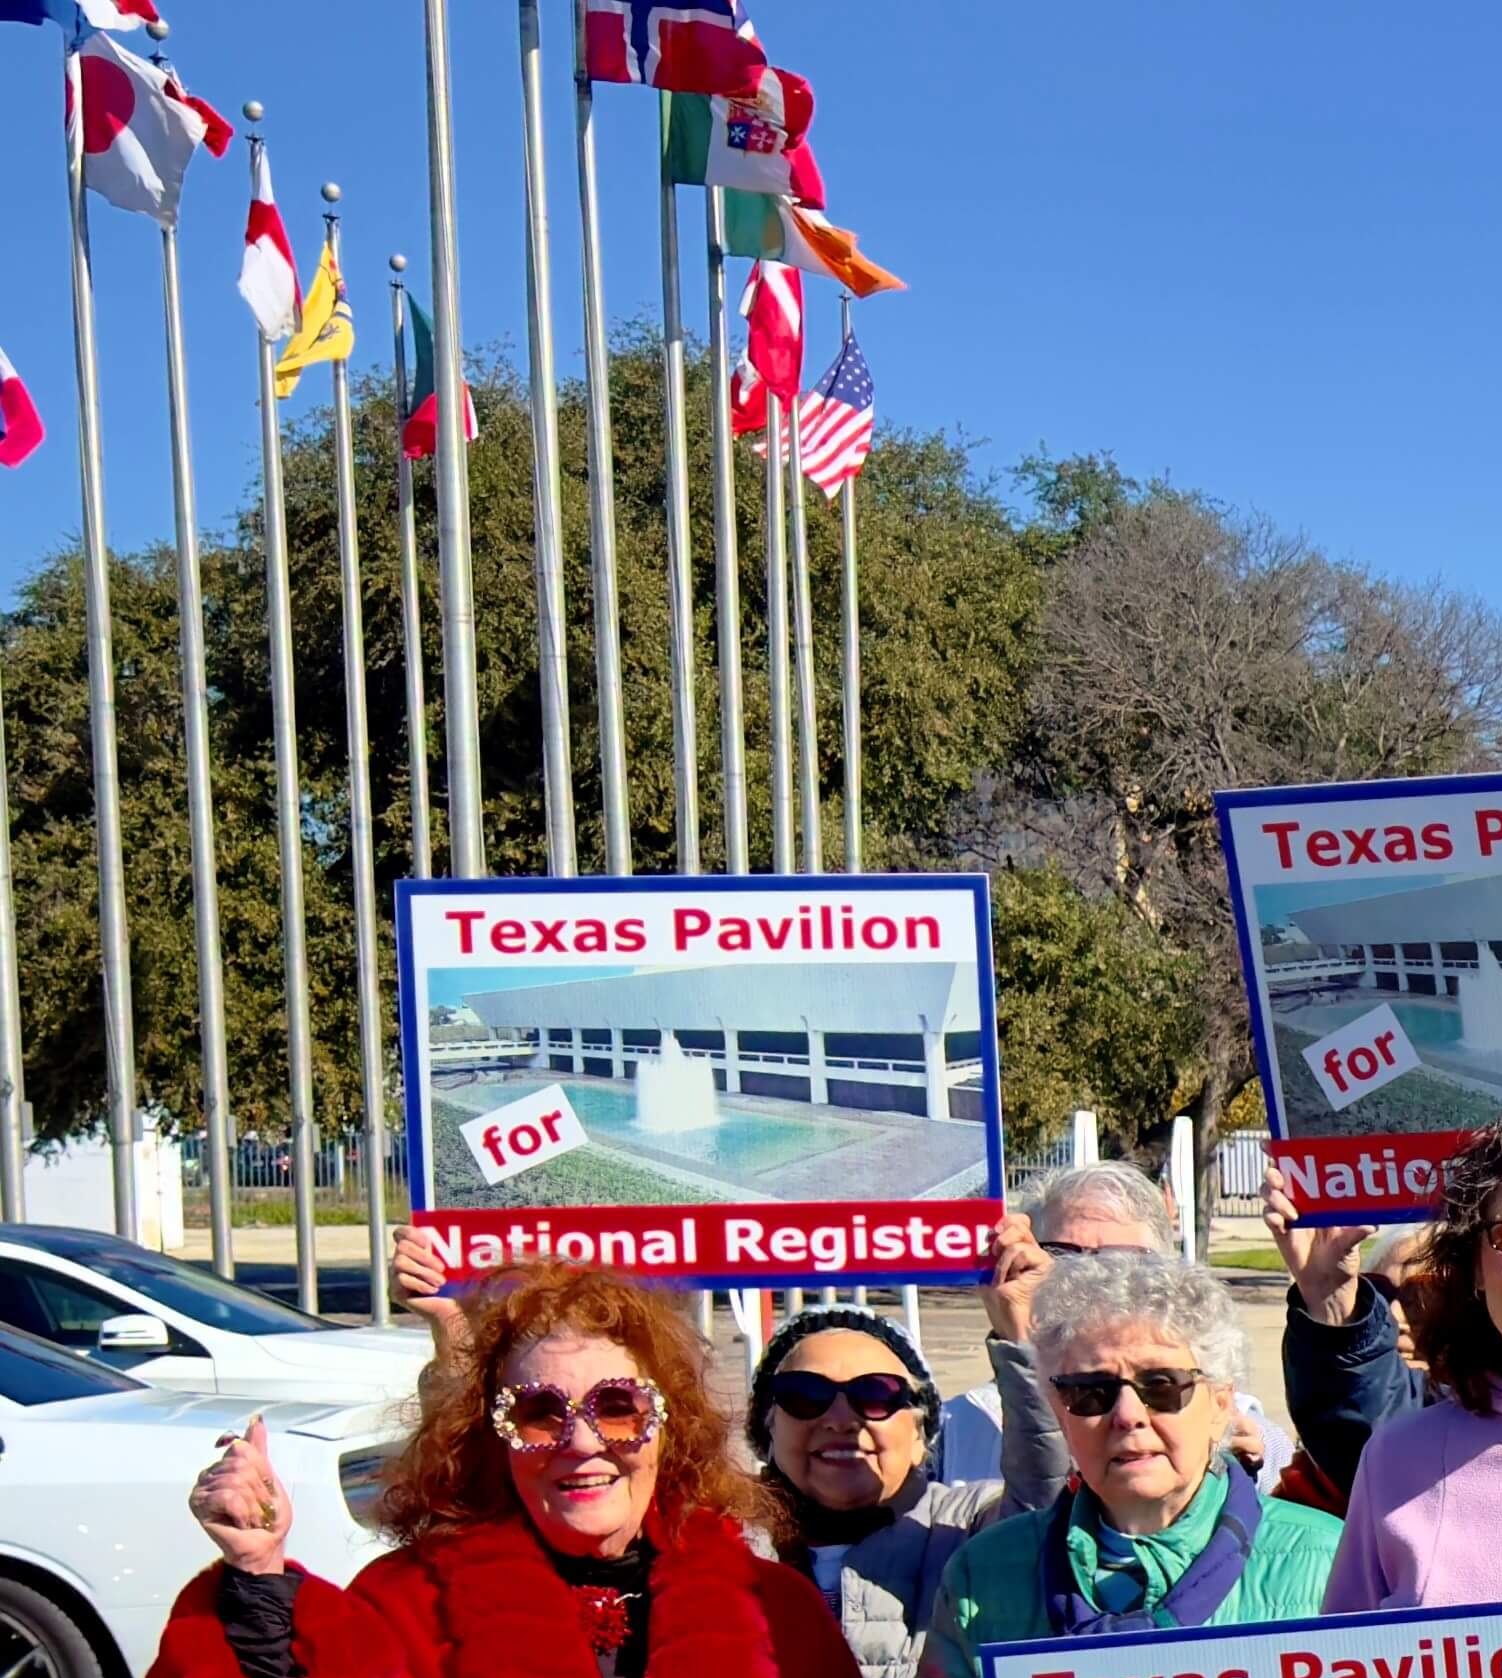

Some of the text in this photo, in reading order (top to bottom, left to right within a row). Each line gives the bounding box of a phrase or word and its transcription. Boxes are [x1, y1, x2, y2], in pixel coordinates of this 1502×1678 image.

[1264, 824, 1452, 868] Texas
[446, 905, 941, 955] Texas Pavilion
[1325, 1033, 1395, 1093] for
[482, 1109, 563, 1168] for
[1278, 1149, 1452, 1200] Natio
[423, 1218, 697, 1269] National
